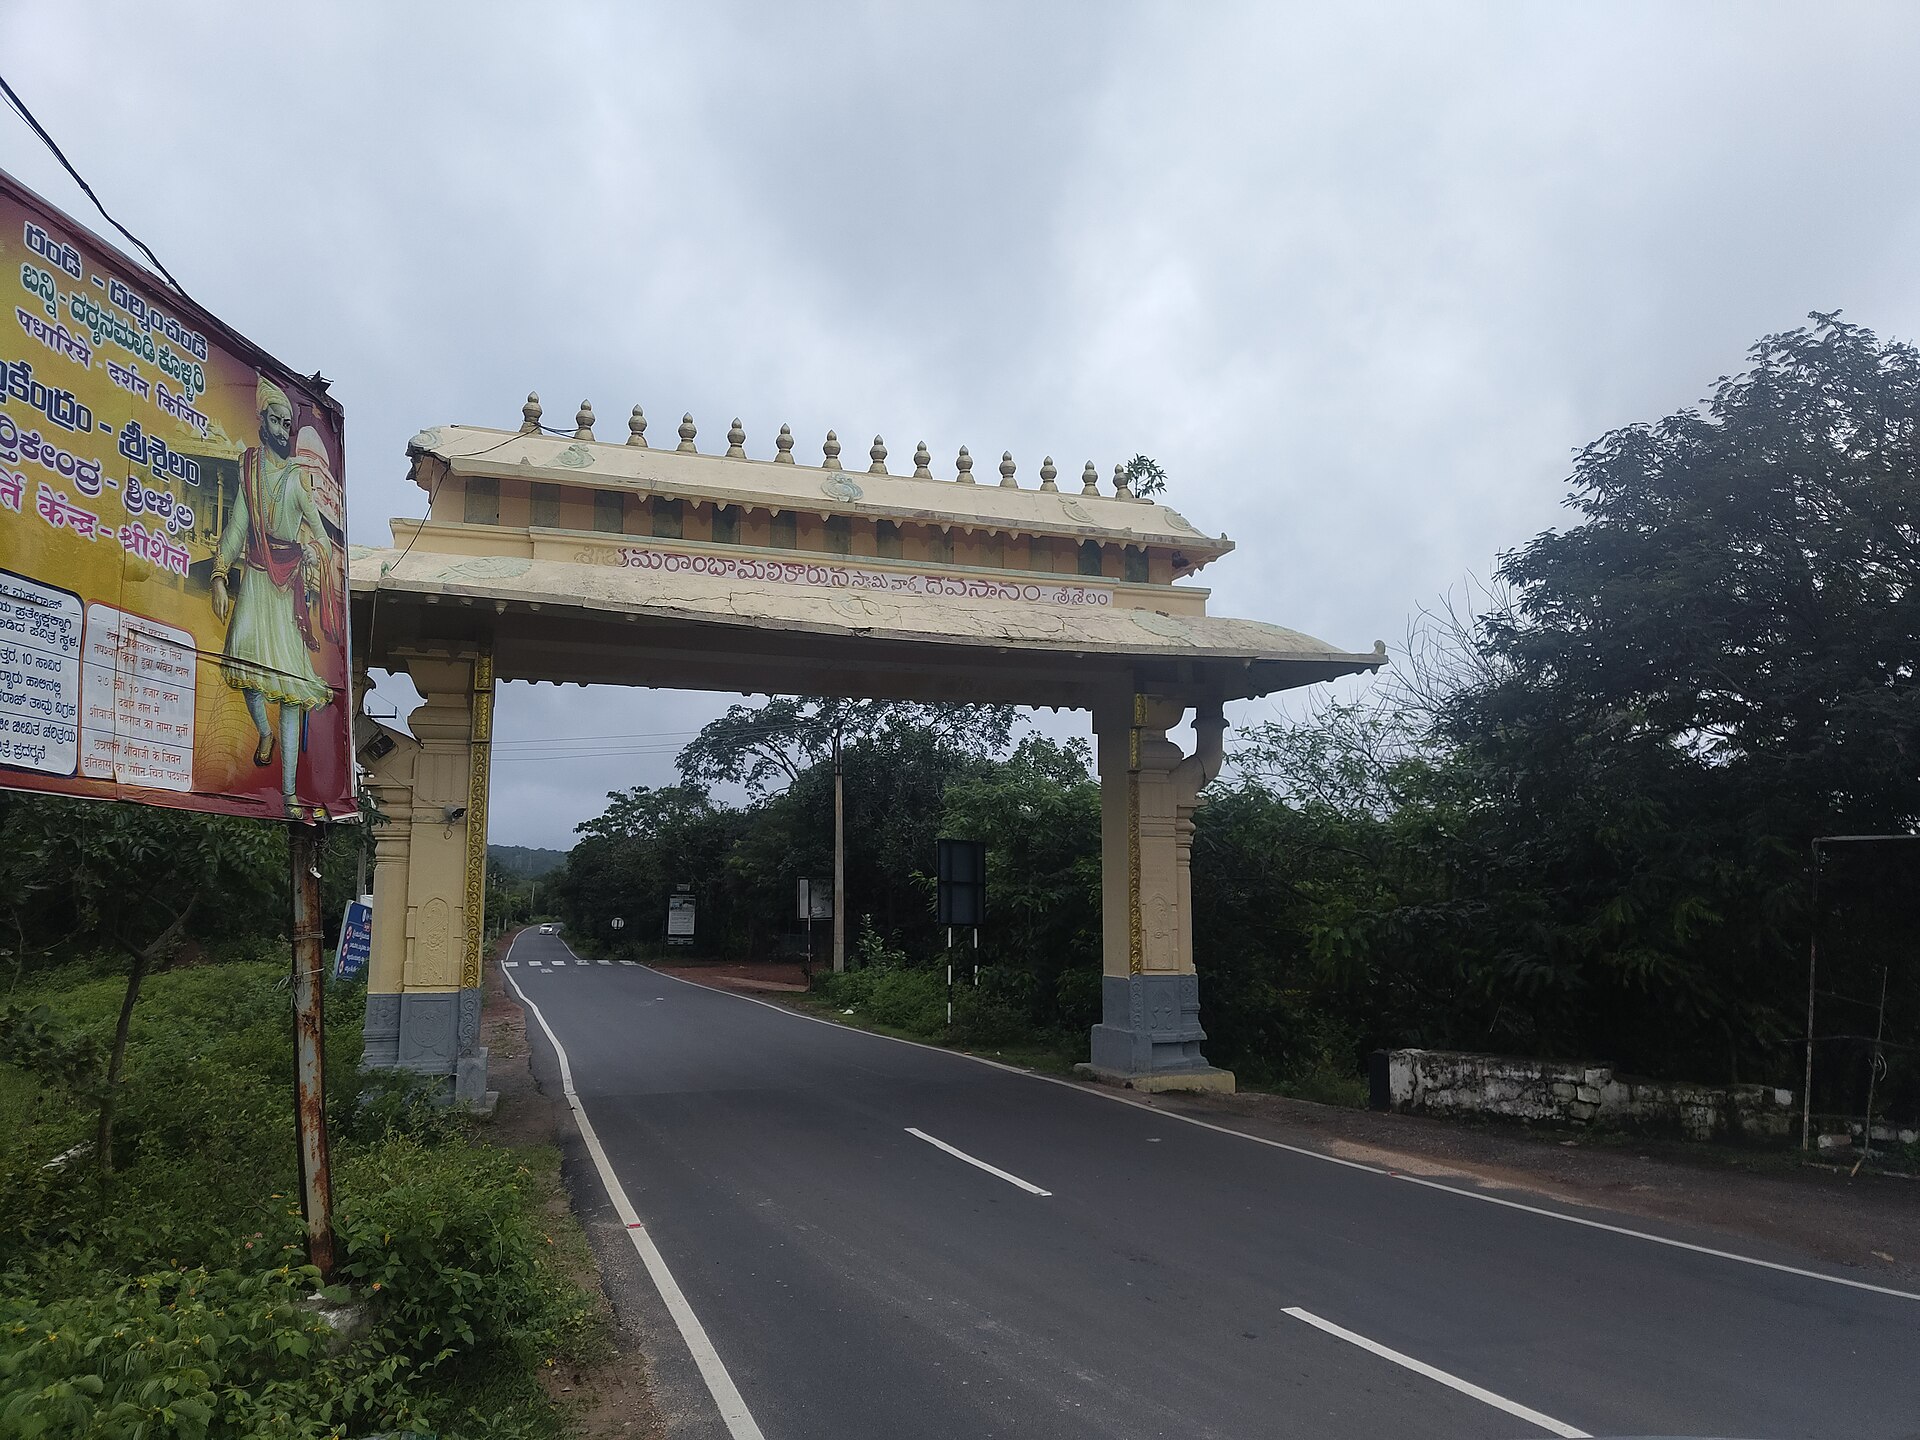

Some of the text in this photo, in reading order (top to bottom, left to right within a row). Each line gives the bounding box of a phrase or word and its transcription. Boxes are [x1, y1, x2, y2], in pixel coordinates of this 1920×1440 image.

[25, 223, 81, 279] రండి
[23, 265, 57, 319] ಬನ್ನಿ
[17, 307, 91, 367] पधारिये
[107, 361, 149, 399] दर्शन
[157, 383, 207, 437] किजिए
[118, 421, 199, 485] శ్రీశైలం
[22, 653, 32, 665] 10
[36, 658, 61, 672] ಸಾವಿರ
